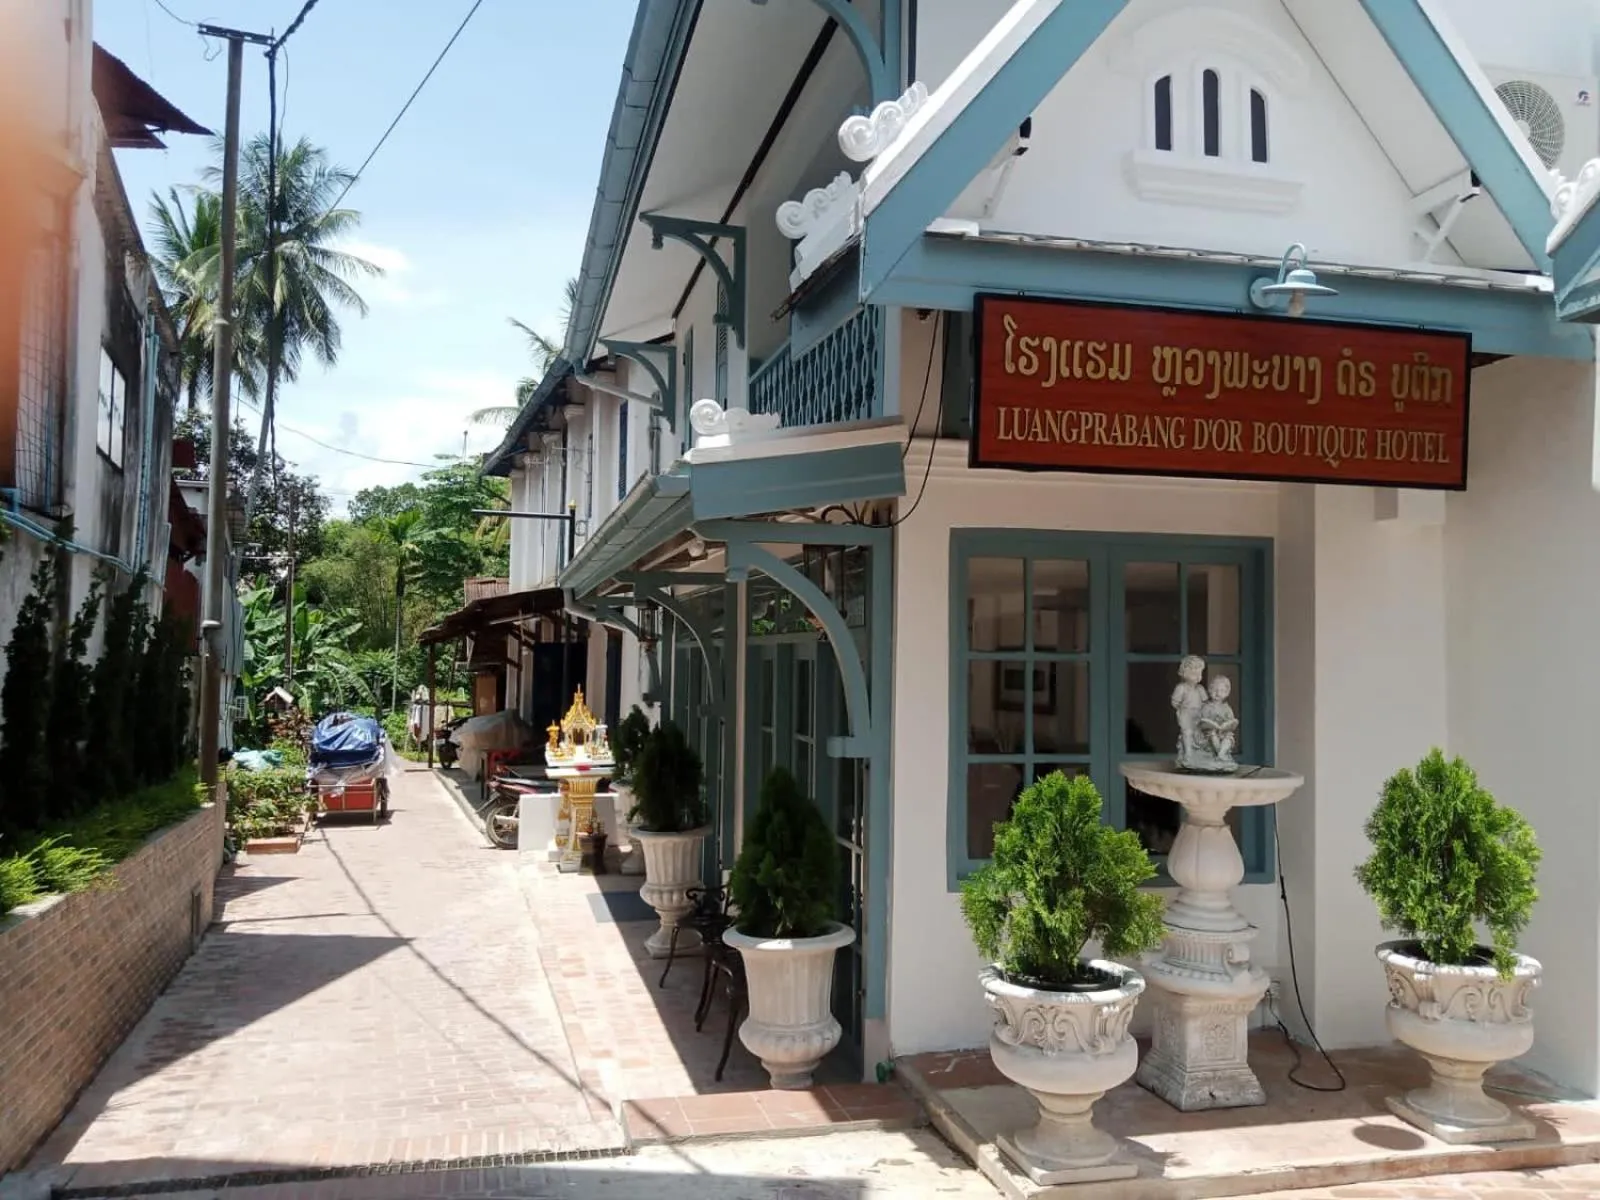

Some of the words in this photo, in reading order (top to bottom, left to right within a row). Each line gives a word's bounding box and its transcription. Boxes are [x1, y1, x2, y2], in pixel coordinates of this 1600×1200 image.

[998, 406, 1186, 449] LUANGPRABANG
[1192, 417, 1244, 453] D'OR
[1251, 420, 1368, 469] BOUTIQUE
[1375, 428, 1450, 464] HOTEL
